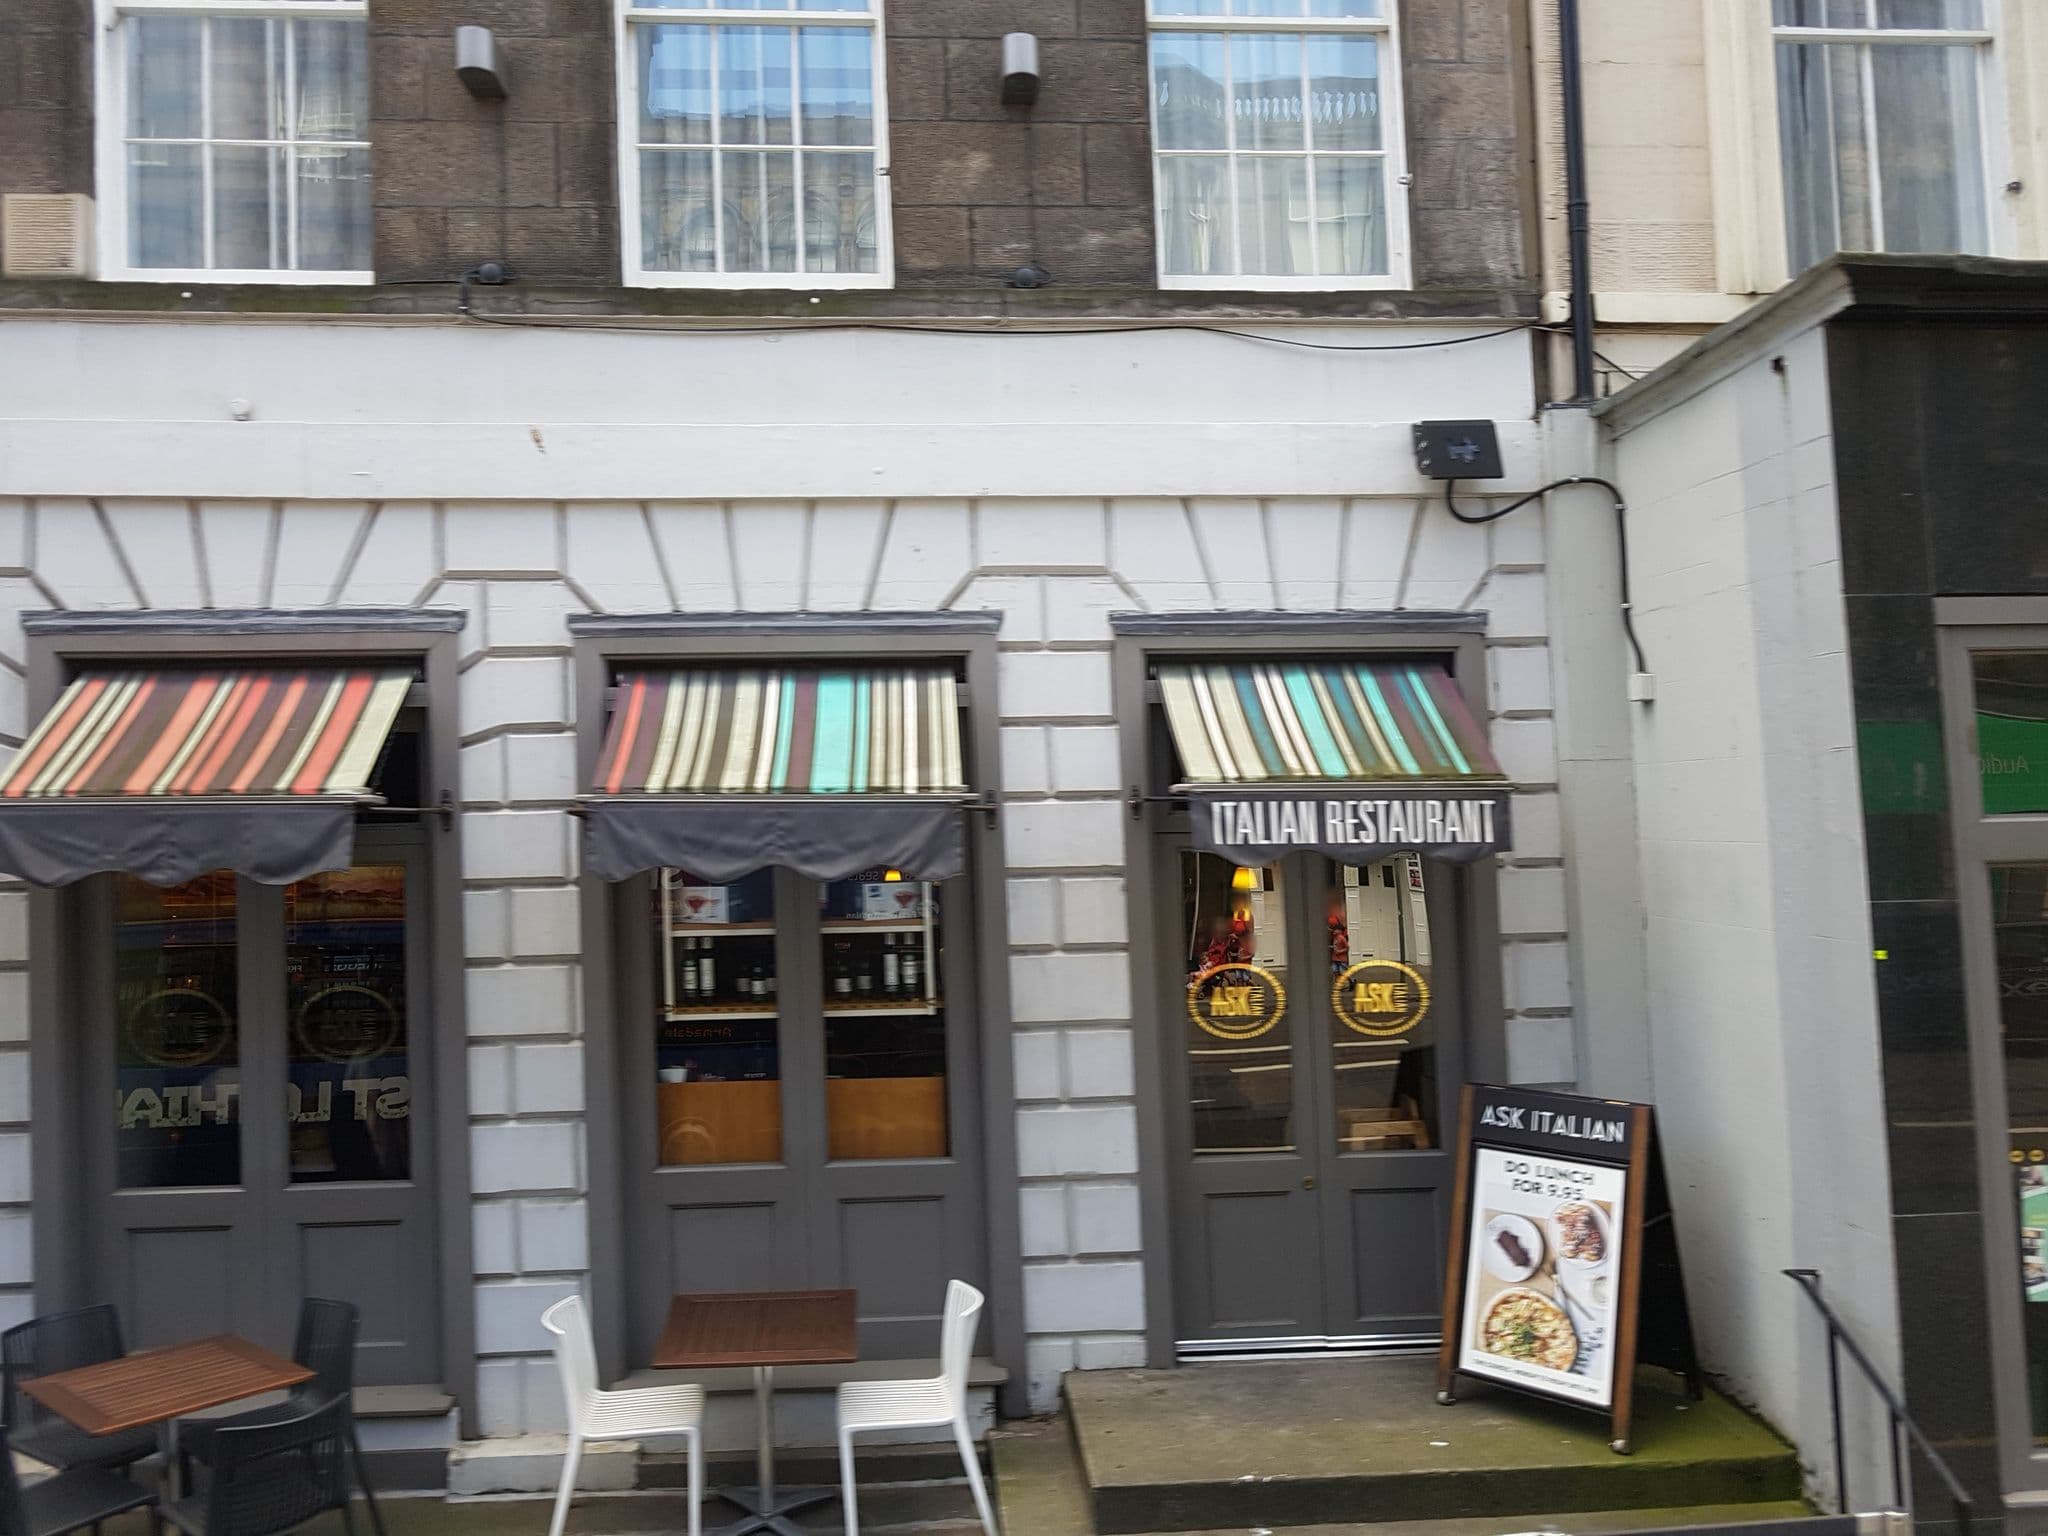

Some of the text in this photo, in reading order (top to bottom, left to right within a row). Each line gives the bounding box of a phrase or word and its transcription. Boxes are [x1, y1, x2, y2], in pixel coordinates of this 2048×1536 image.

[1211, 800, 1497, 845] ITALIAN RESTAURANT
[1210, 986, 1250, 1016] ASK
[1353, 983, 1393, 1013] ASK
[1480, 1104, 1625, 1142] ASK ITALIAN
[1504, 1160, 1594, 1185] DO LUNCH
[1512, 1178, 1543, 1194] FOR
